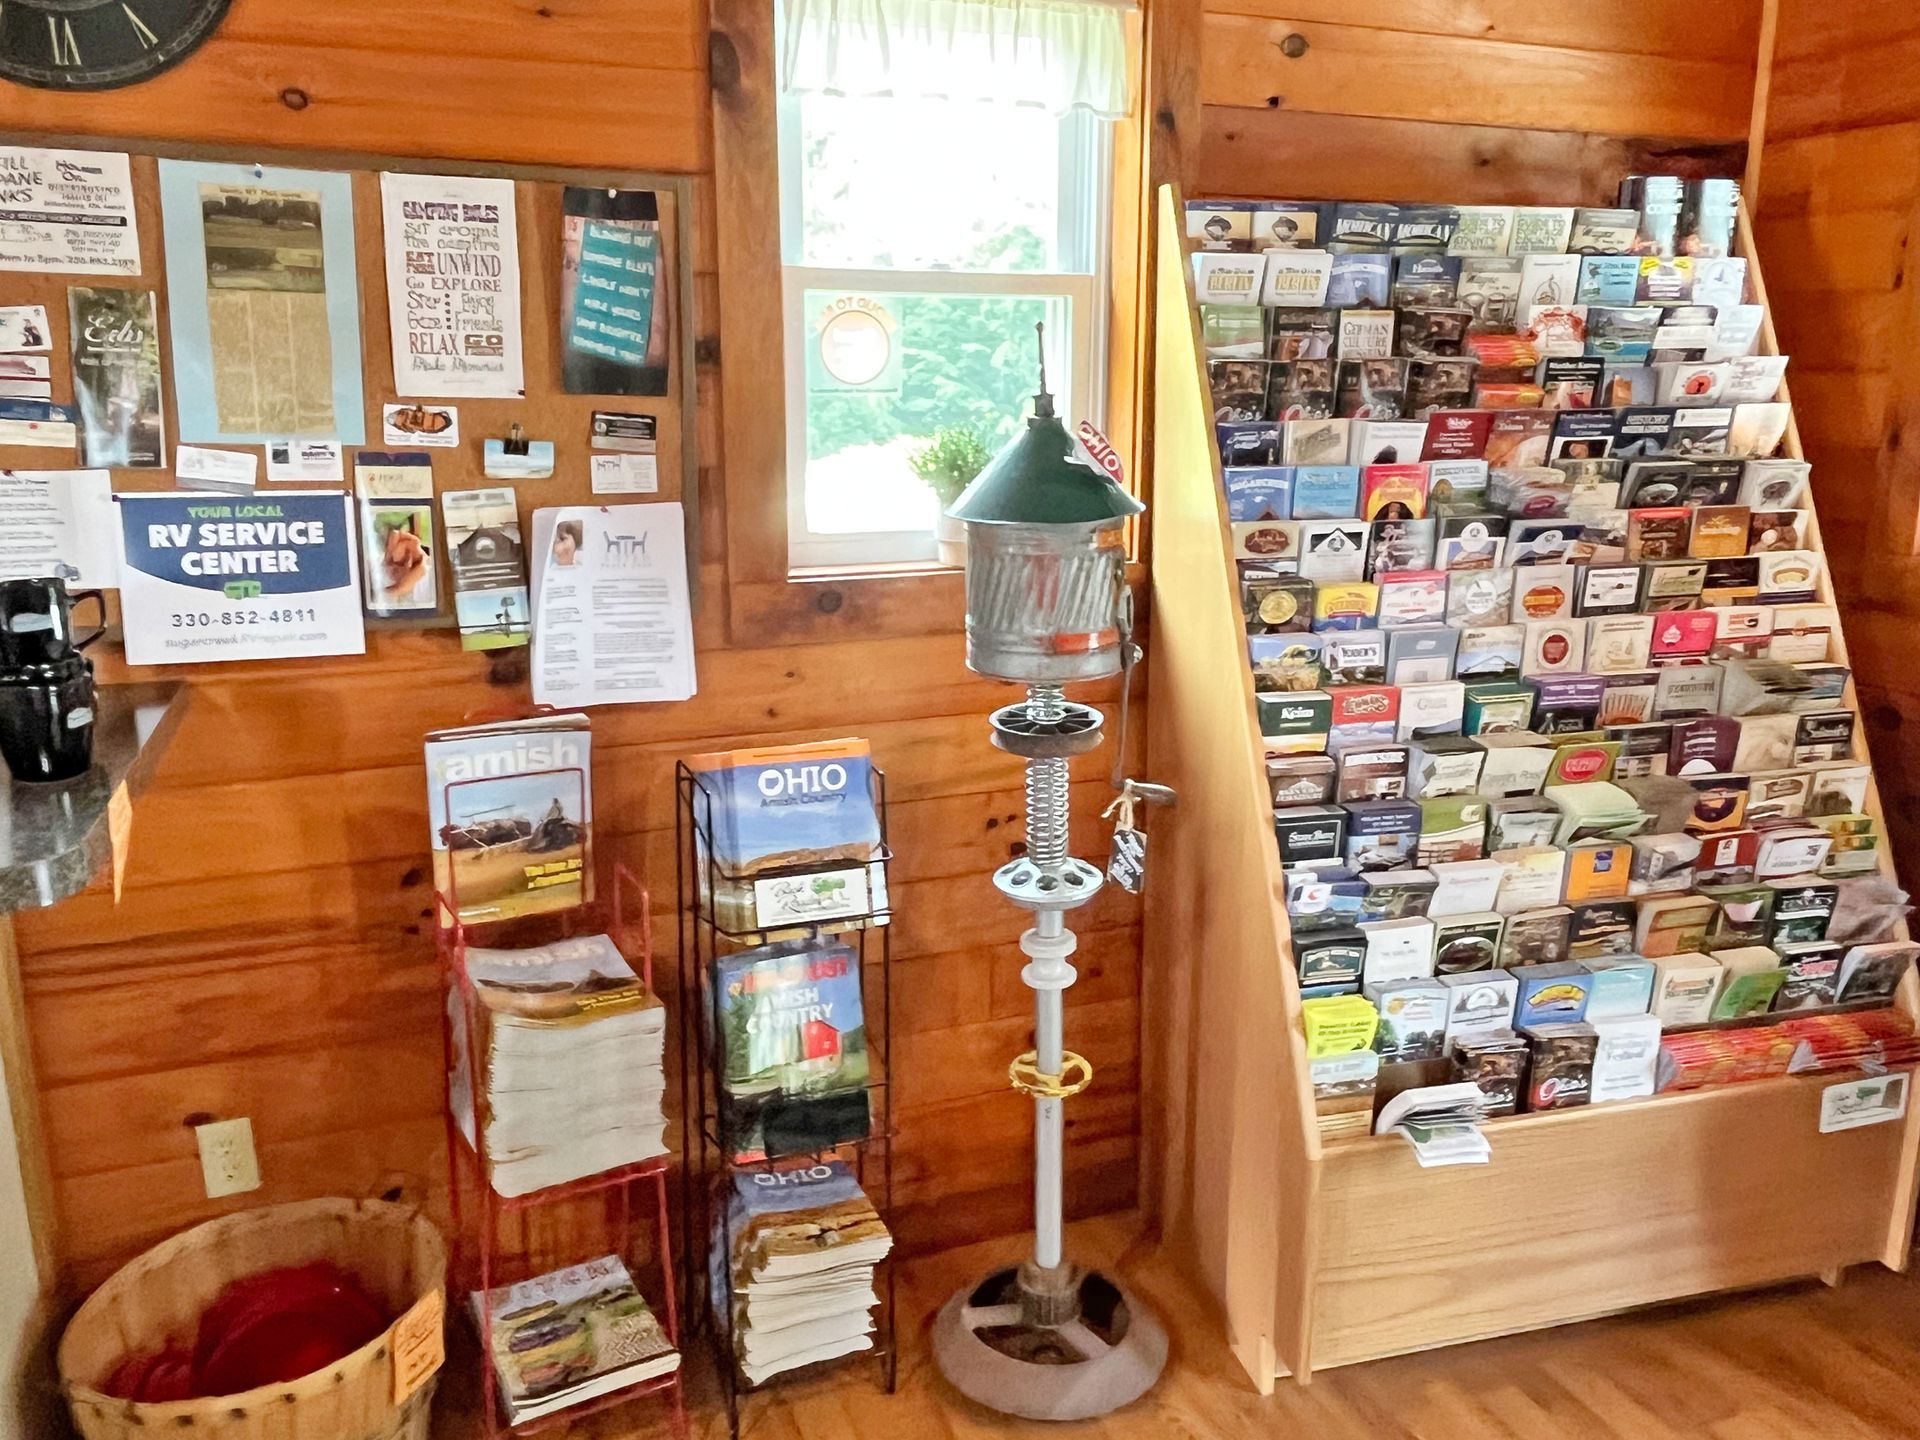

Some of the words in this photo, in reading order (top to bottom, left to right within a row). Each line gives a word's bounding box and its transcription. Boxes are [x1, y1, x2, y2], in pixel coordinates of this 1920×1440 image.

[437, 252, 501, 277] UNWIND
[431, 277, 502, 292] EXPLORE
[409, 332, 459, 355] RELAX
[1077, 424, 1120, 472] OHIO
[187, 505, 232, 518] YOUR
[235, 504, 284, 518] LOCAL
[148, 523, 192, 548] RV
[198, 521, 325, 547] SERVICE
[180, 549, 300, 576] CENTER
[171, 608, 315, 628] 330-852-4811
[446, 737, 580, 781] amish
[757, 763, 848, 797] OHIO
[753, 1165, 833, 1186] OHIO
